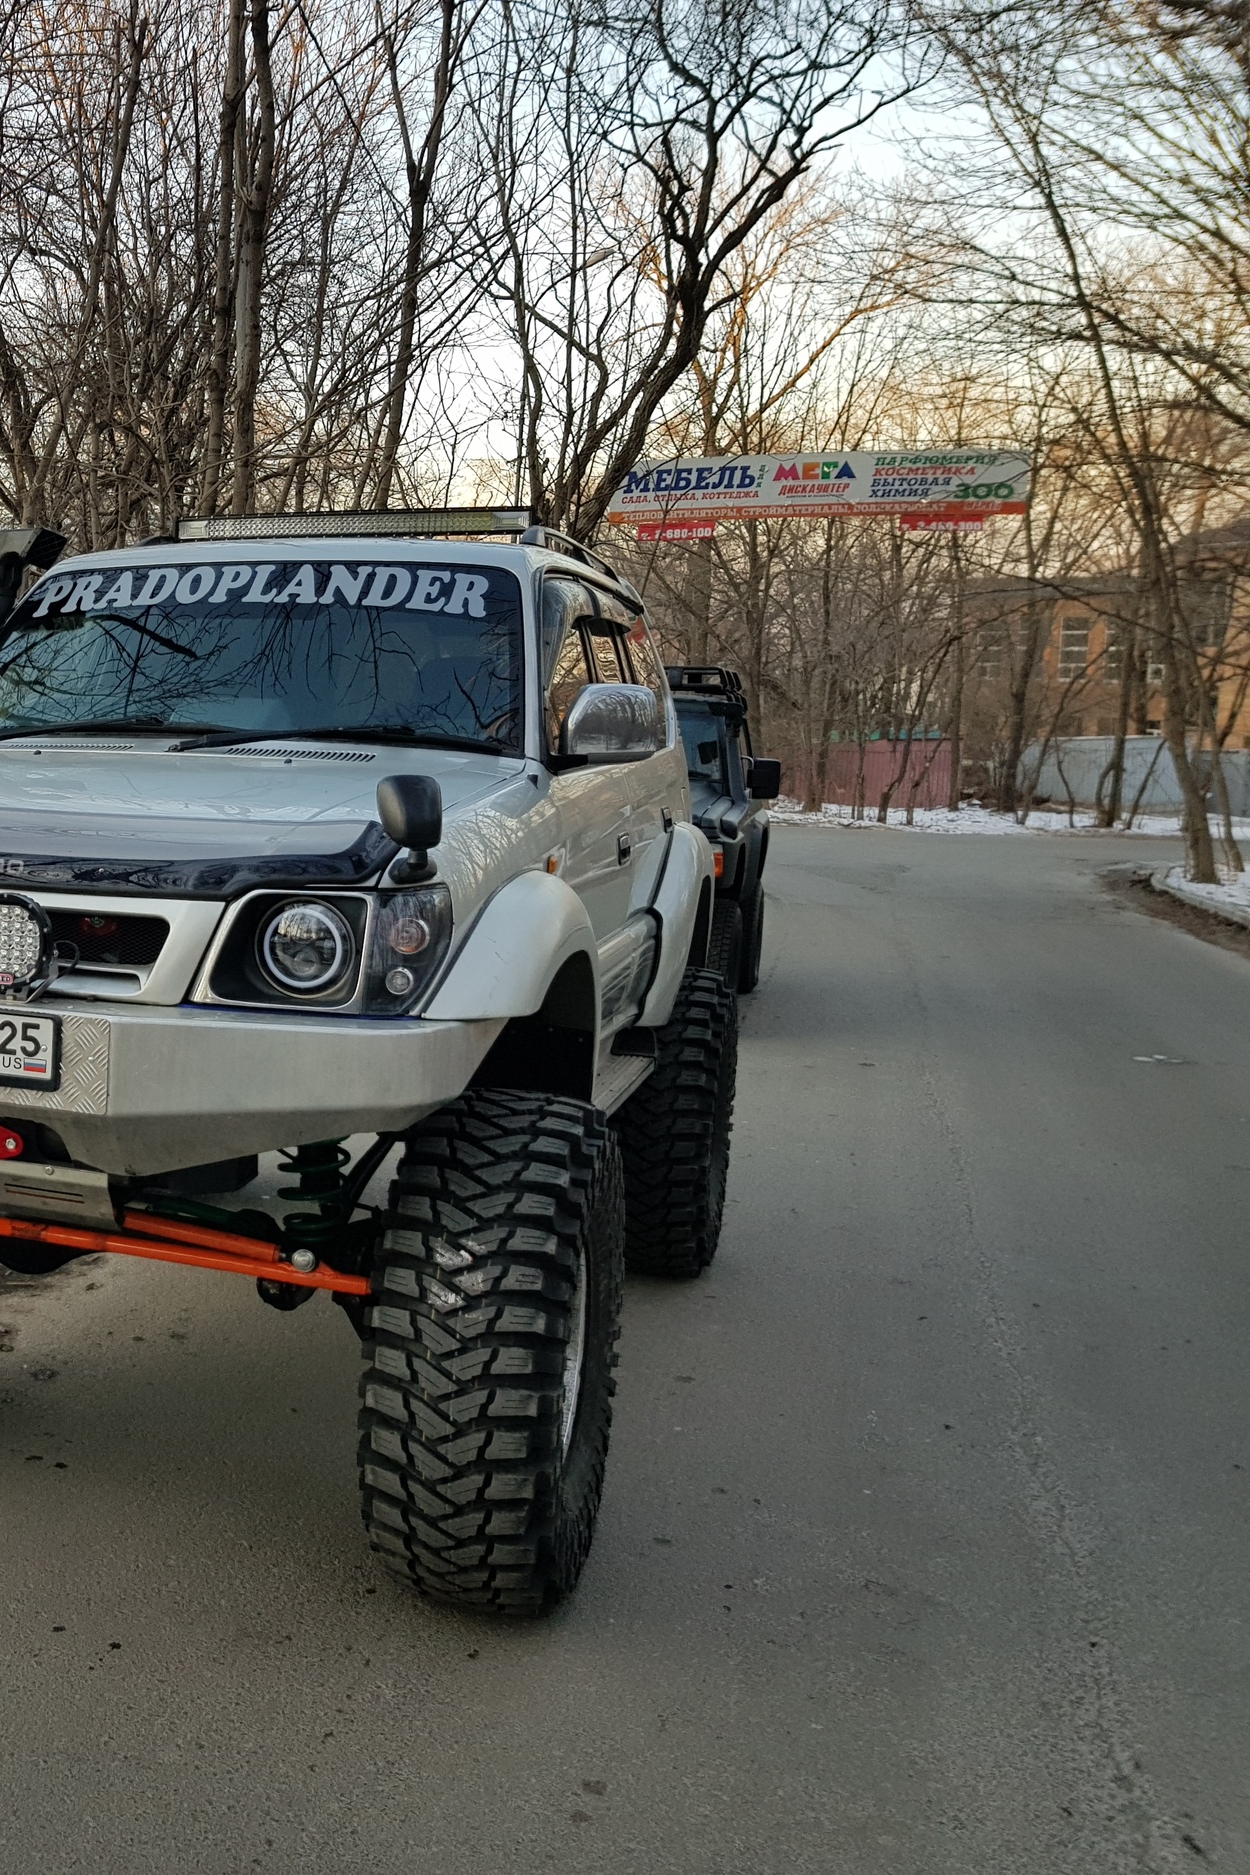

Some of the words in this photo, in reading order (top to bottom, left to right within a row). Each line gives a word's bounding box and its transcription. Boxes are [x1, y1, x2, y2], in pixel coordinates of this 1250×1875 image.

[875, 454, 998, 466] ПАРФЮМЕРИЯ
[772, 460, 856, 481] МЕГА
[872, 466, 977, 477] КОСМЕТИКА
[623, 465, 756, 494] МЕБЕЛЬ
[870, 476, 953, 488] БЫТОВАЯ
[701, 490, 760, 500] КОТТЕДЖА
[869, 487, 932, 498] ХИМИЯ
[623, 508, 740, 521] ТЕПЛОВНТИЛЯТОРЫ,
[32, 563, 489, 619] PRADOPLANDER
